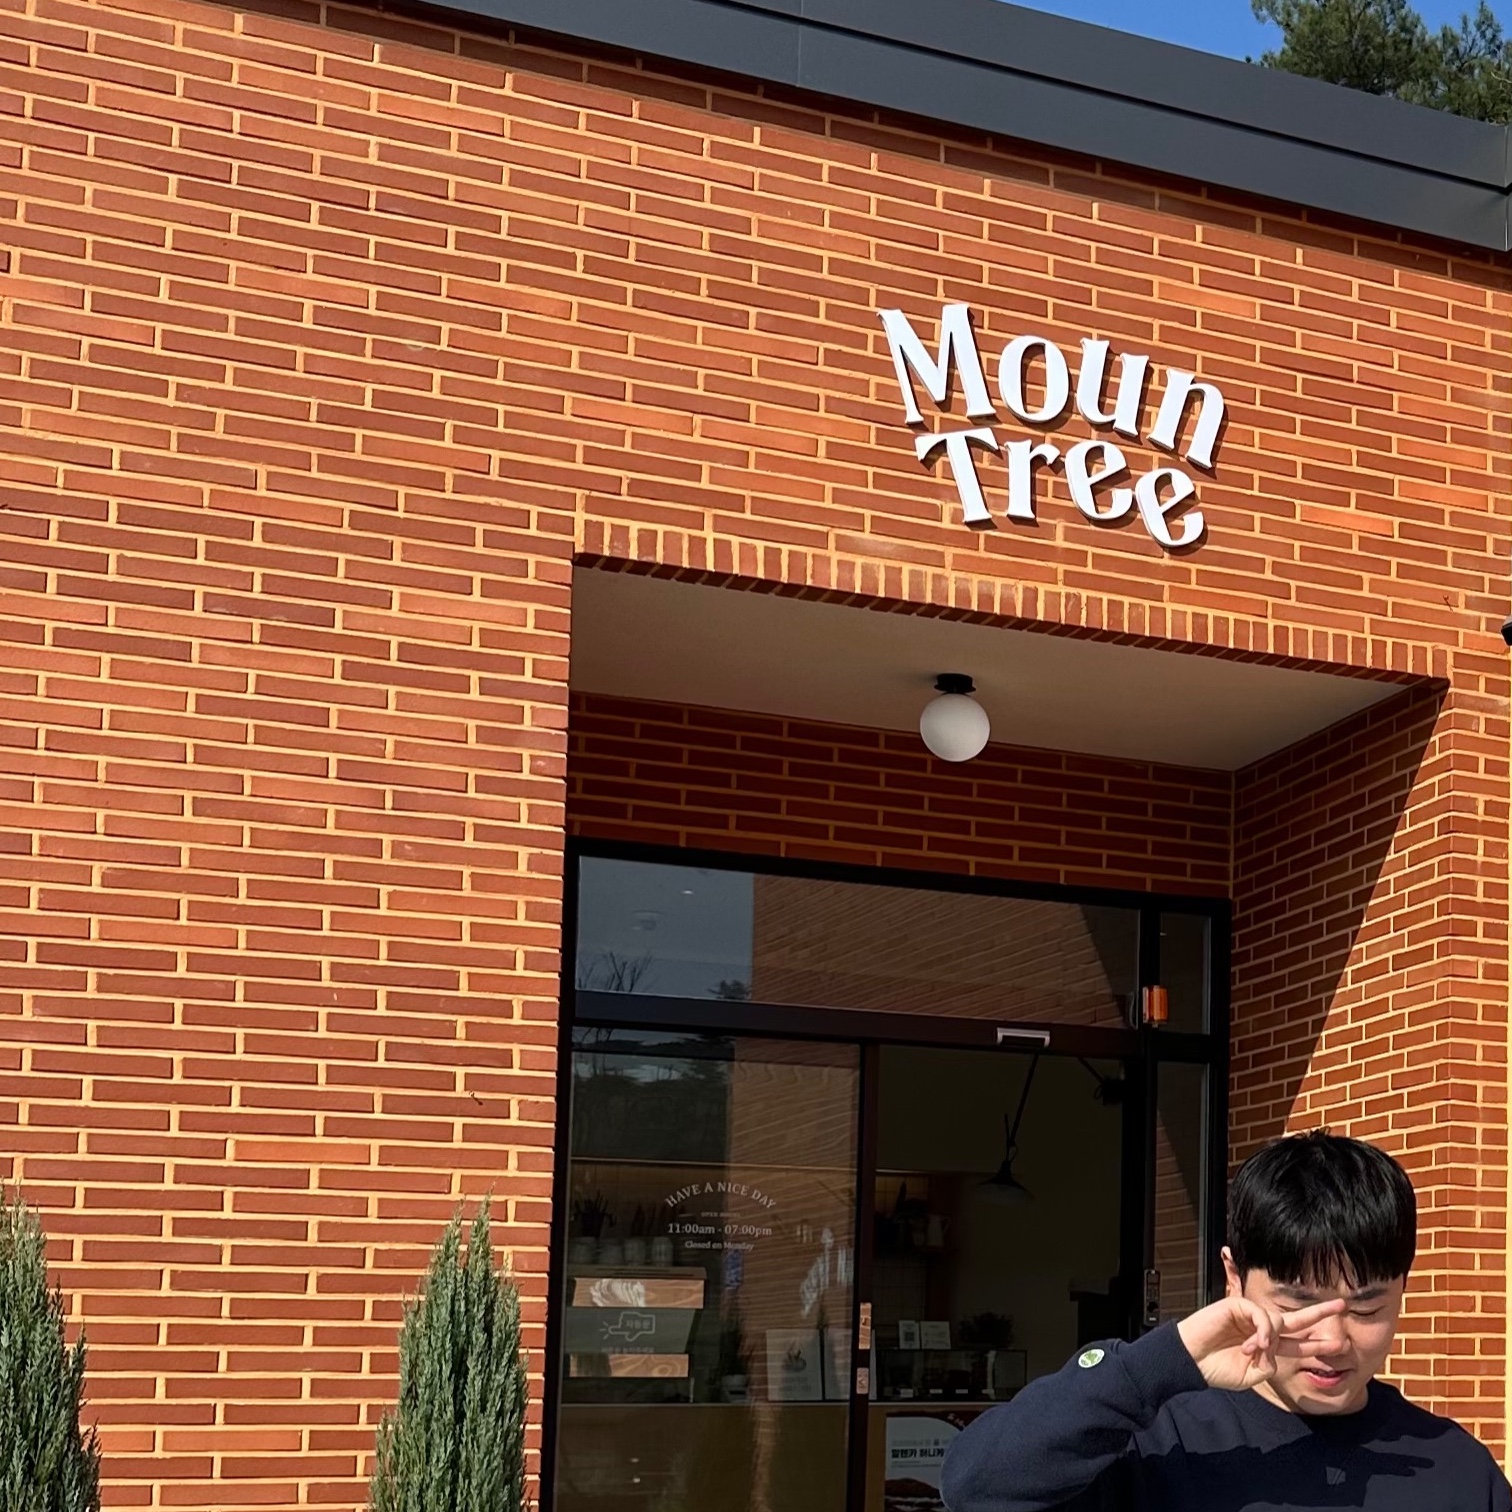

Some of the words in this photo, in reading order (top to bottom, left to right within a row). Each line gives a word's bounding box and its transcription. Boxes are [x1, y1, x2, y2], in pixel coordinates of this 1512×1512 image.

[876, 303, 1225, 469] Moun
[915, 427, 1205, 548] Tree
[665, 1183, 701, 1208] HAVE
[704, 1182, 714, 1193] A
[717, 1182, 750, 1196] NICE
[751, 1189, 777, 1209] DAY
[668, 1223, 715, 1235] 11:00am
[724, 1225, 773, 1238] 07:00pm
[685, 1241, 711, 1250] Closed
[724, 1241, 755, 1252] Monday
